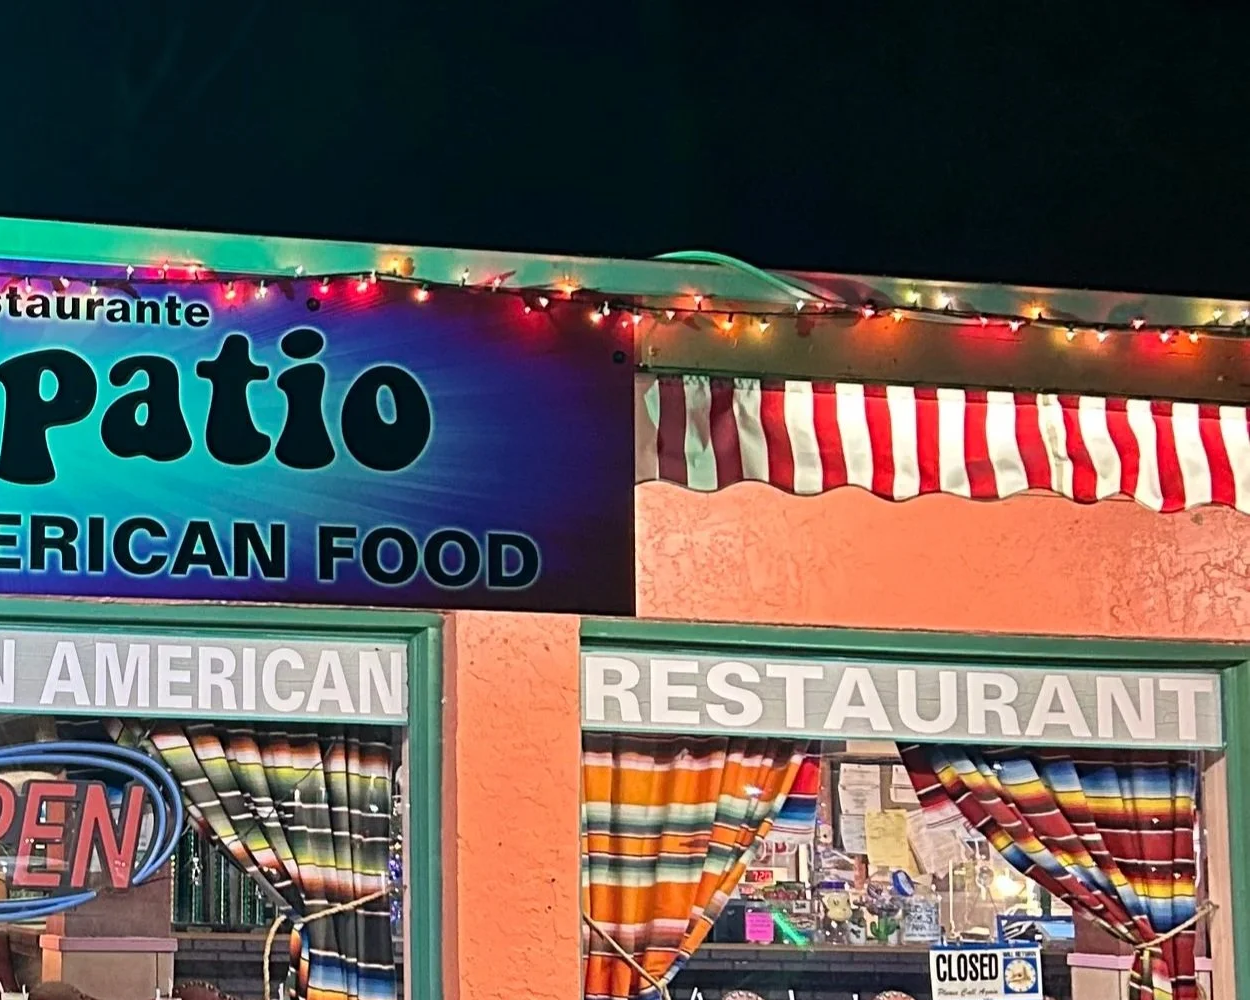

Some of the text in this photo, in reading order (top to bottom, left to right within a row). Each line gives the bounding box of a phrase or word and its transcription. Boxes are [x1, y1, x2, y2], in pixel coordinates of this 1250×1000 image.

[318, 525, 541, 590] FOOD
[39, 640, 404, 715] AMERICAN
[584, 655, 1217, 741] RESTAURANT
[936, 953, 999, 982] CLOSED
